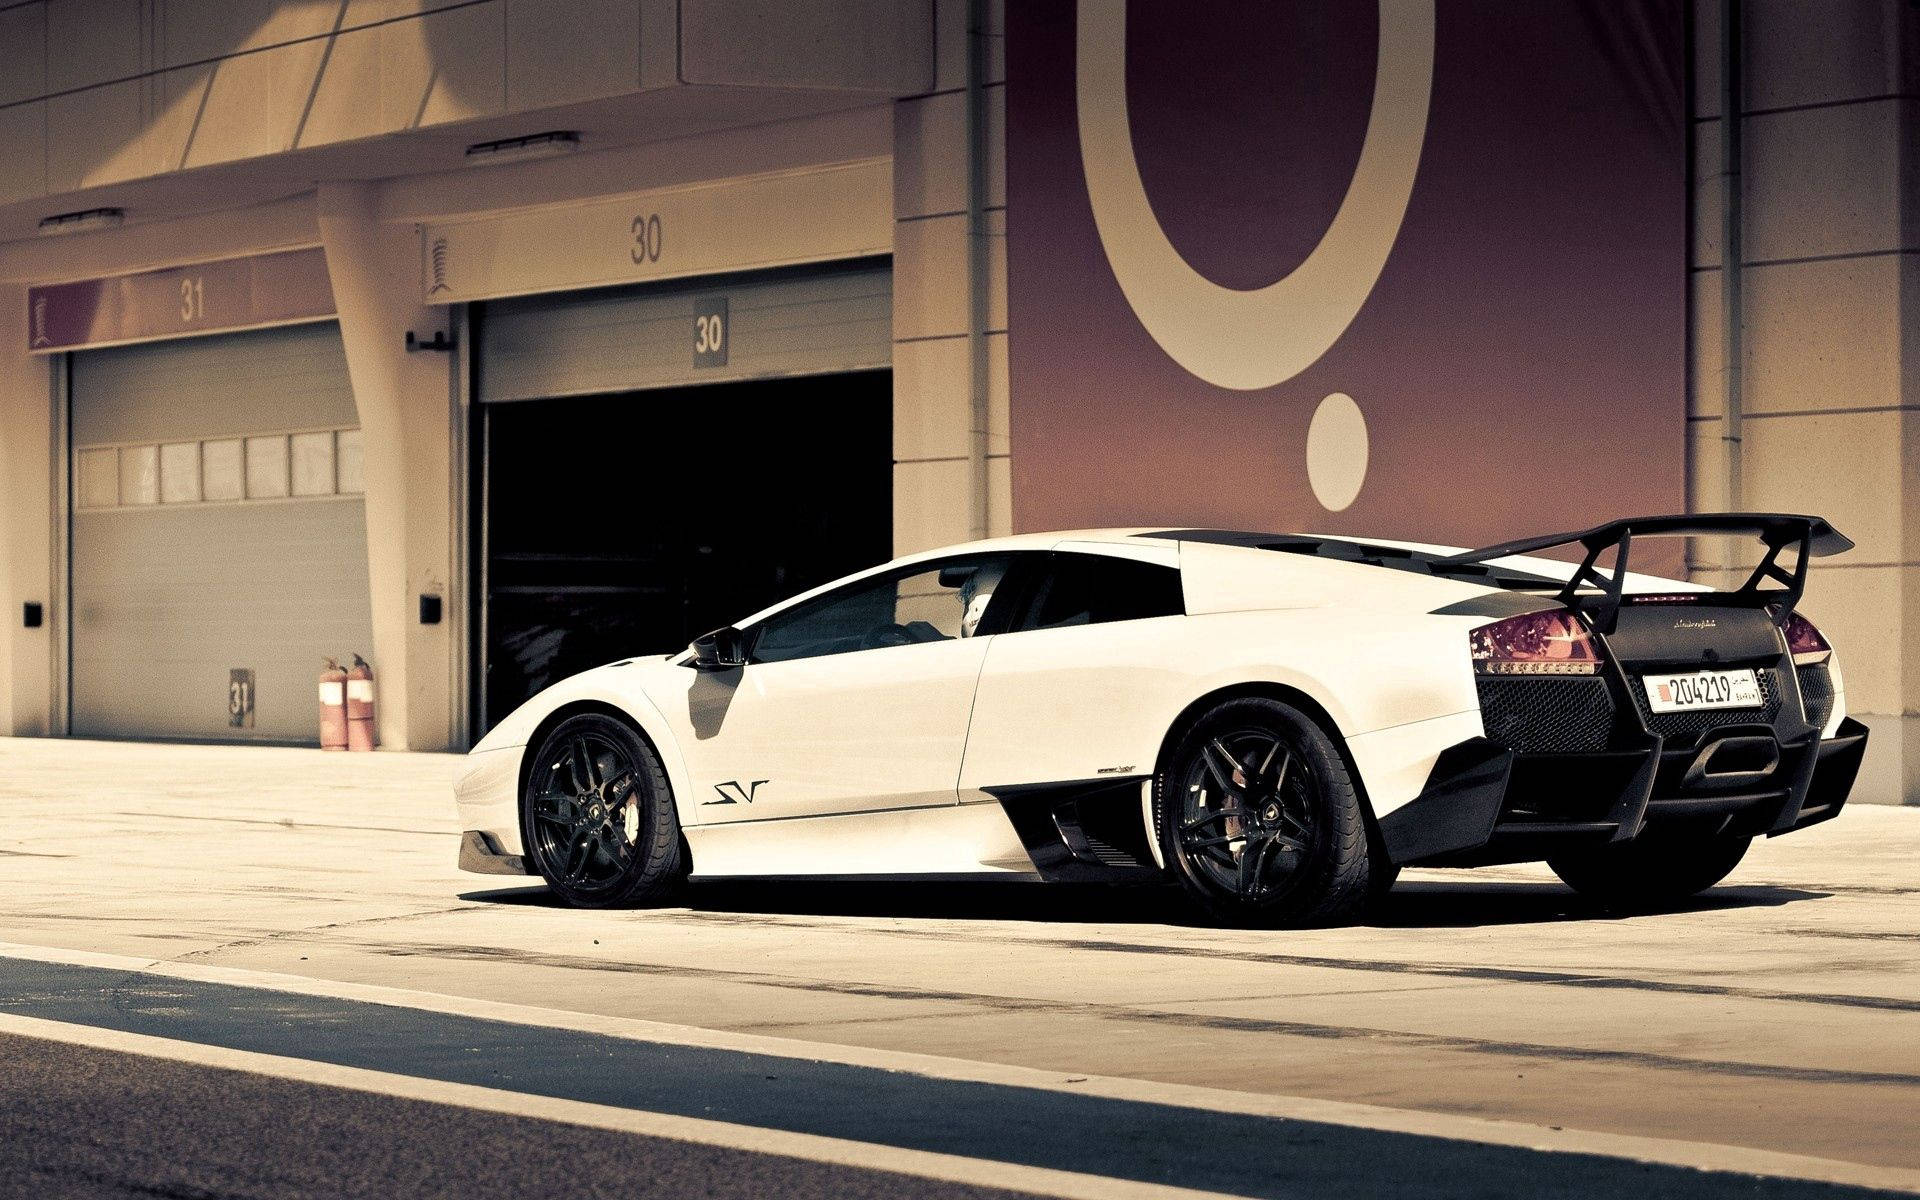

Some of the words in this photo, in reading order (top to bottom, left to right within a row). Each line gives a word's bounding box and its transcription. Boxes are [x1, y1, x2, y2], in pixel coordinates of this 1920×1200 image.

[631, 213, 662, 265] 30
[181, 278, 202, 320] 31
[696, 314, 723, 353] 30
[231, 681, 248, 714] 31
[1670, 676, 1731, 705] 204219
